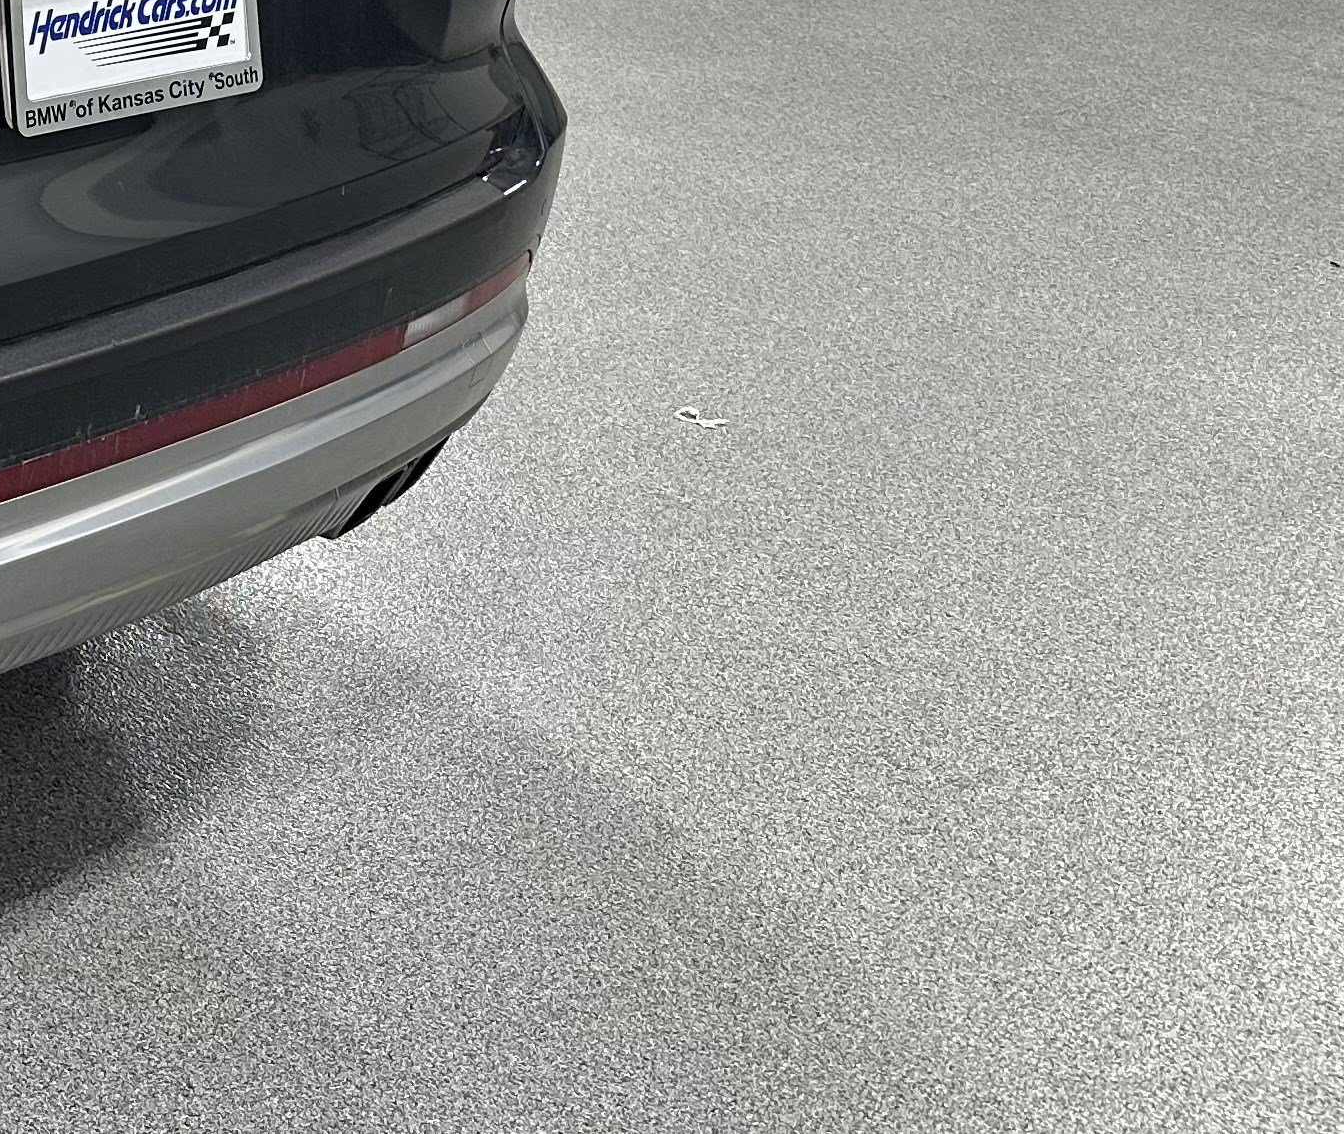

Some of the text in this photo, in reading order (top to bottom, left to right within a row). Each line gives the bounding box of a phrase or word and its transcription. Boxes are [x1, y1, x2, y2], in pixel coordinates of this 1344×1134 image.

[25, 66, 259, 129] BMW of Kansas City South
